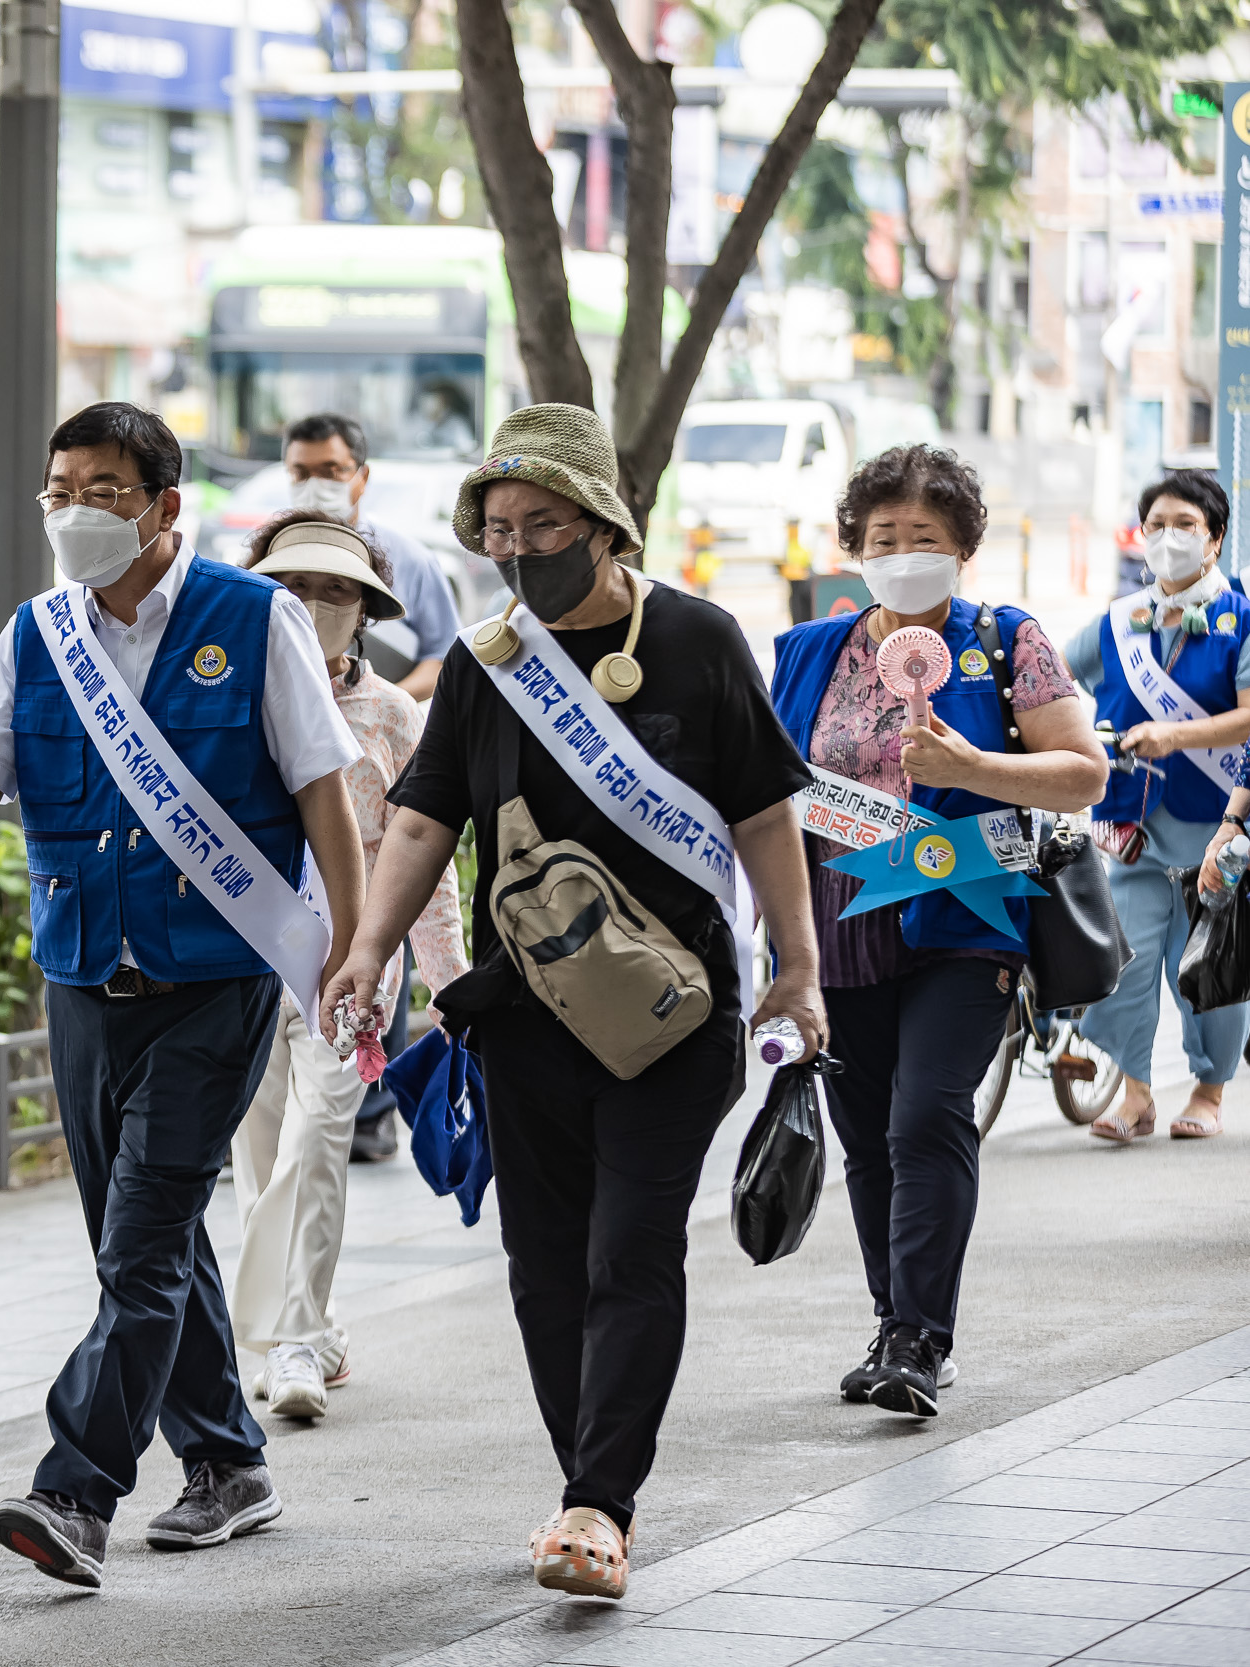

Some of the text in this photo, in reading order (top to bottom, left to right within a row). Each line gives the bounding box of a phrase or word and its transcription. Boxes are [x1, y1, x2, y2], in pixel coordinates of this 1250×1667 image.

[46, 589, 255, 900] 법질서 확립을 위한 기초질서 지키기 운동
[512, 654, 732, 884] 법질서 확립을 위한 기초질서 지키기
[807, 803, 881, 846] 철저히
